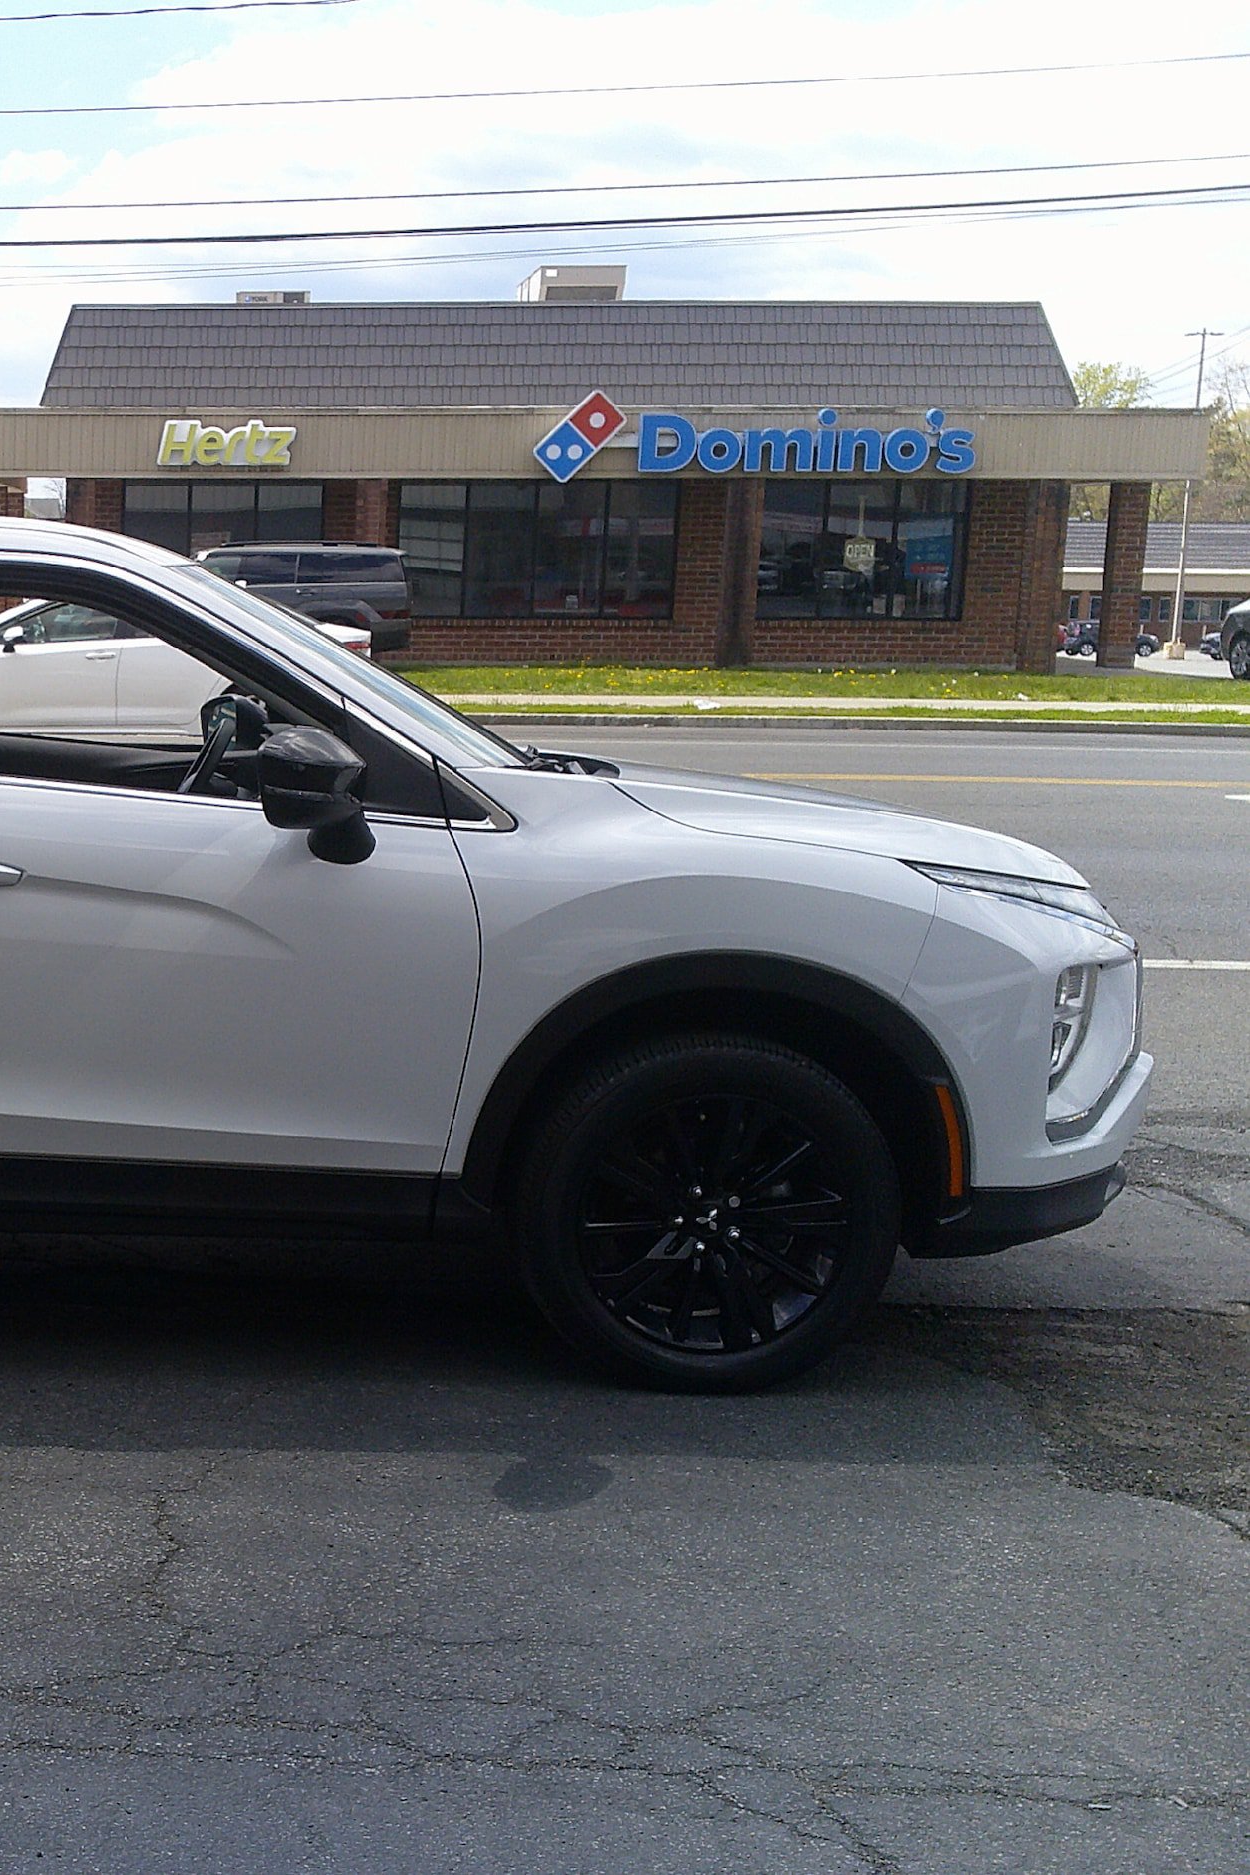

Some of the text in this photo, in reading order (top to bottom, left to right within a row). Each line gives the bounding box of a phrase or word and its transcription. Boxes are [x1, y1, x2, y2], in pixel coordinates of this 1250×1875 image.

[159, 421, 295, 465] Hertz
[637, 407, 977, 474] Domino's
[846, 544, 875, 558] OPEN
